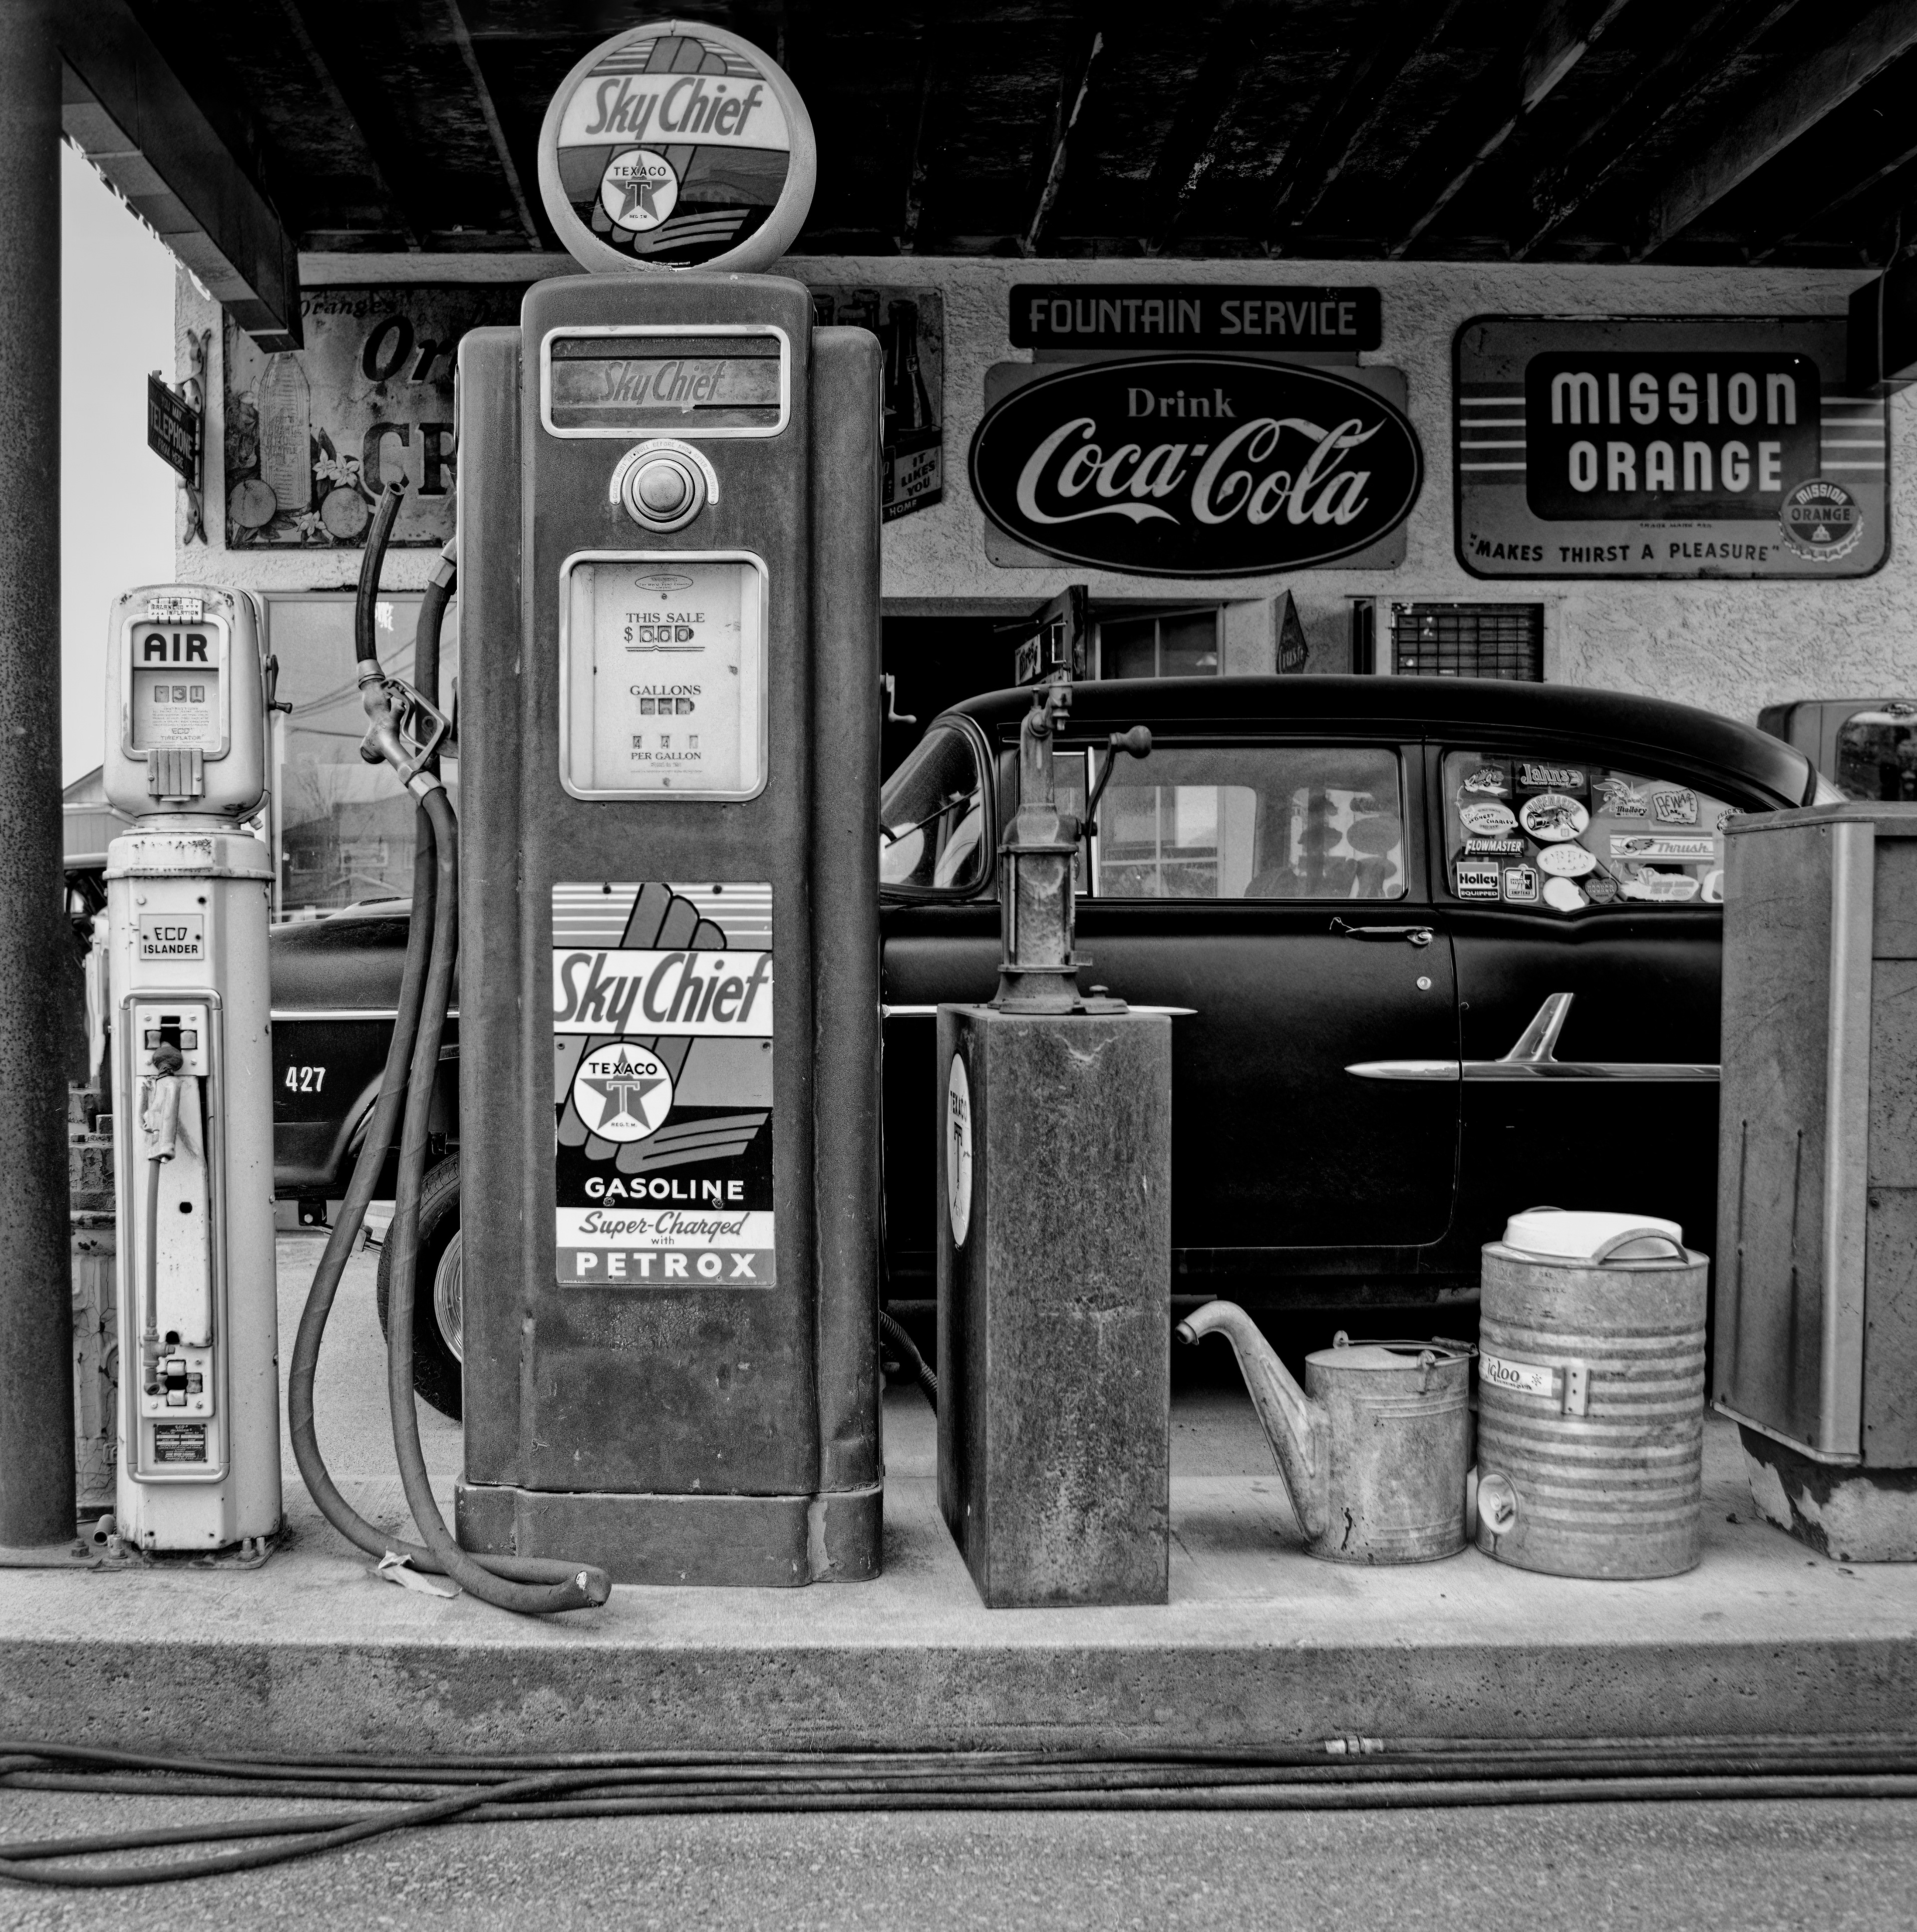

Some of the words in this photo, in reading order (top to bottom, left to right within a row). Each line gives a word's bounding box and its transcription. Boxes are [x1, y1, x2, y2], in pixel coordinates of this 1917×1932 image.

[585, 77, 658, 140] Sky
[659, 77, 763, 136] Chief
[614, 166, 666, 177] TEXACO
[626, 180, 651, 208] T
[1029, 300, 1200, 333] FOUNTAIN
[1220, 301, 1357, 335] SERVICE
[600, 362, 653, 405] Sky
[653, 361, 726, 401] Chief
[1127, 388, 1237, 418] Drink
[1551, 372, 1796, 425] MISSION
[150, 399, 193, 462] TELEPHONE
[913, 452, 927, 467] IT
[1016, 417, 1387, 525] Coca-Cola
[1569, 440, 1781, 492] ORANGE
[901, 460, 935, 487] LIKES
[907, 476, 930, 496] YOU
[1796, 484, 1848, 505] MISSION
[890, 499, 917, 516] HOME
[1792, 508, 1850, 521] ORANGE
[1560, 545, 1630, 563] THIRST
[1641, 544, 1654, 560] A
[626, 613, 660, 623] THIS
[666, 613, 705, 623] SALE
[144, 633, 208, 662] AIR
[631, 685, 701, 695] GALLONS
[1521, 764, 1570, 785] Jahns
[1655, 793, 1695, 817] BEWARE
[1464, 840, 1523, 855] FLOWMASTER
[1656, 842, 1709, 853] Thrush
[1459, 873, 1498, 887] Holley
[154, 927, 187, 941] ECO
[144, 945, 198, 954] ISLANDER
[554, 953, 643, 1033] Sky
[642, 952, 772, 1022] Chief
[286, 1066, 325, 1092] 427
[589, 1062, 657, 1075] TEXACO
[607, 1081, 640, 1113] T
[585, 1177, 744, 1200] GASOLINE
[579, 1211, 750, 1243] Super-Charged
[651, 1236, 674, 1245] with
[577, 1252, 756, 1278] PETROX
[1487, 1357, 1520, 1382] igloo
